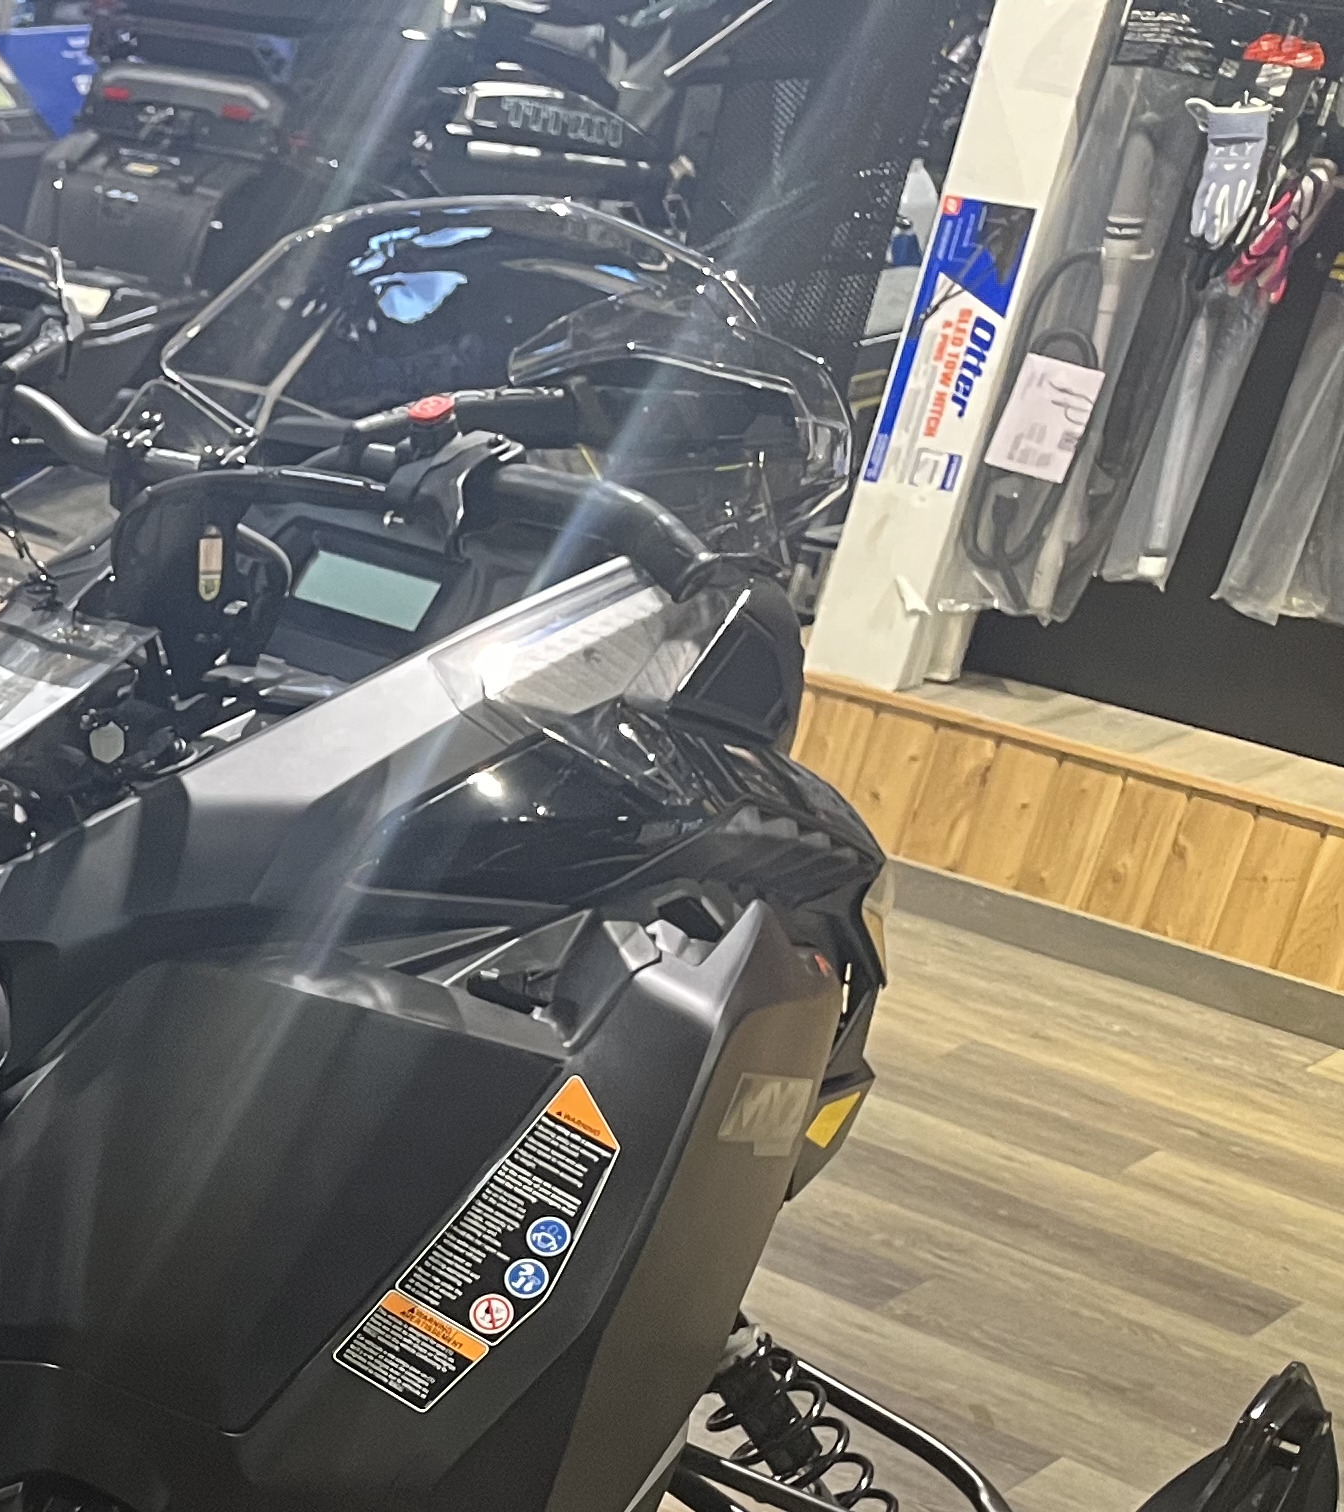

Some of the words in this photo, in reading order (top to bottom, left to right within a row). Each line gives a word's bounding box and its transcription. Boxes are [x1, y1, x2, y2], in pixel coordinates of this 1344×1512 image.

[939, 351, 961, 388] TOW
[951, 315, 997, 419] Otter
[923, 390, 948, 439] HITCH
[563, 1113, 601, 1138] WARNING
[414, 1307, 454, 1335] WARNING
